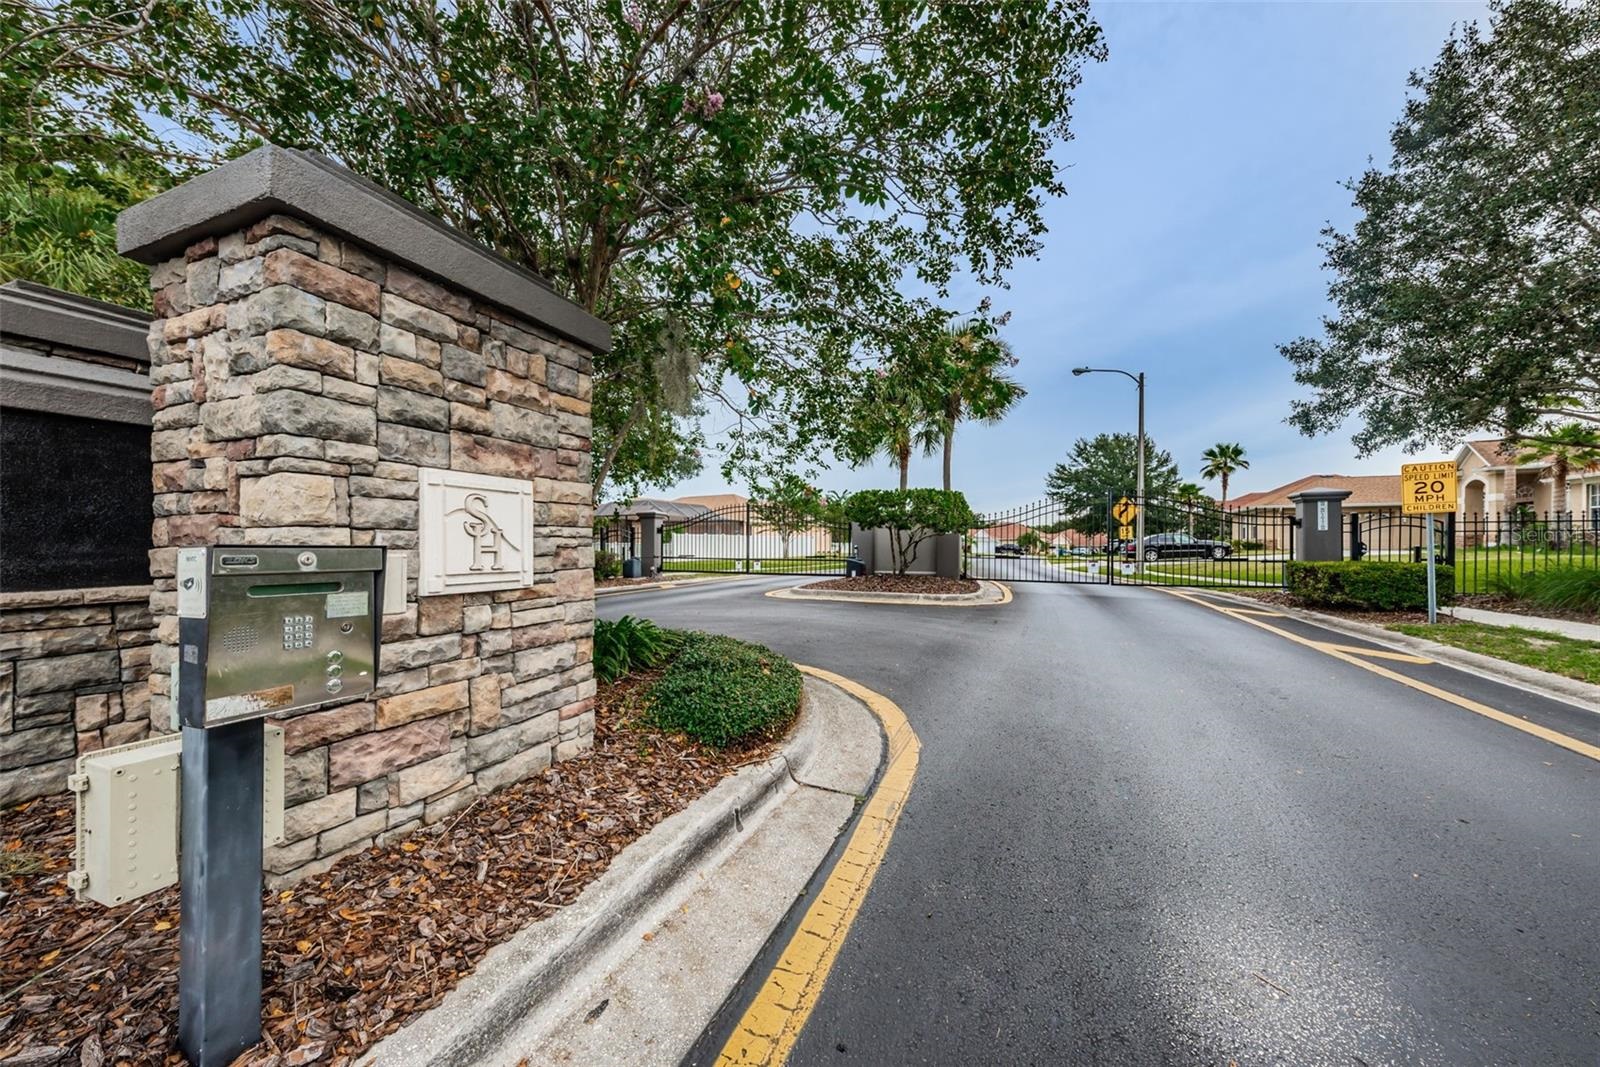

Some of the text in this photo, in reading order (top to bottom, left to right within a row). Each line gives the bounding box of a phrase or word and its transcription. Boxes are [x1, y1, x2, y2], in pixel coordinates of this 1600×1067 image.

[1404, 463, 1454, 473] CAUTION
[1404, 472, 1454, 481] SPEED LIMIT
[1414, 480, 1445, 494] 20
[1414, 494, 1445, 502] MPH
[1406, 503, 1454, 511] CHILDREN
